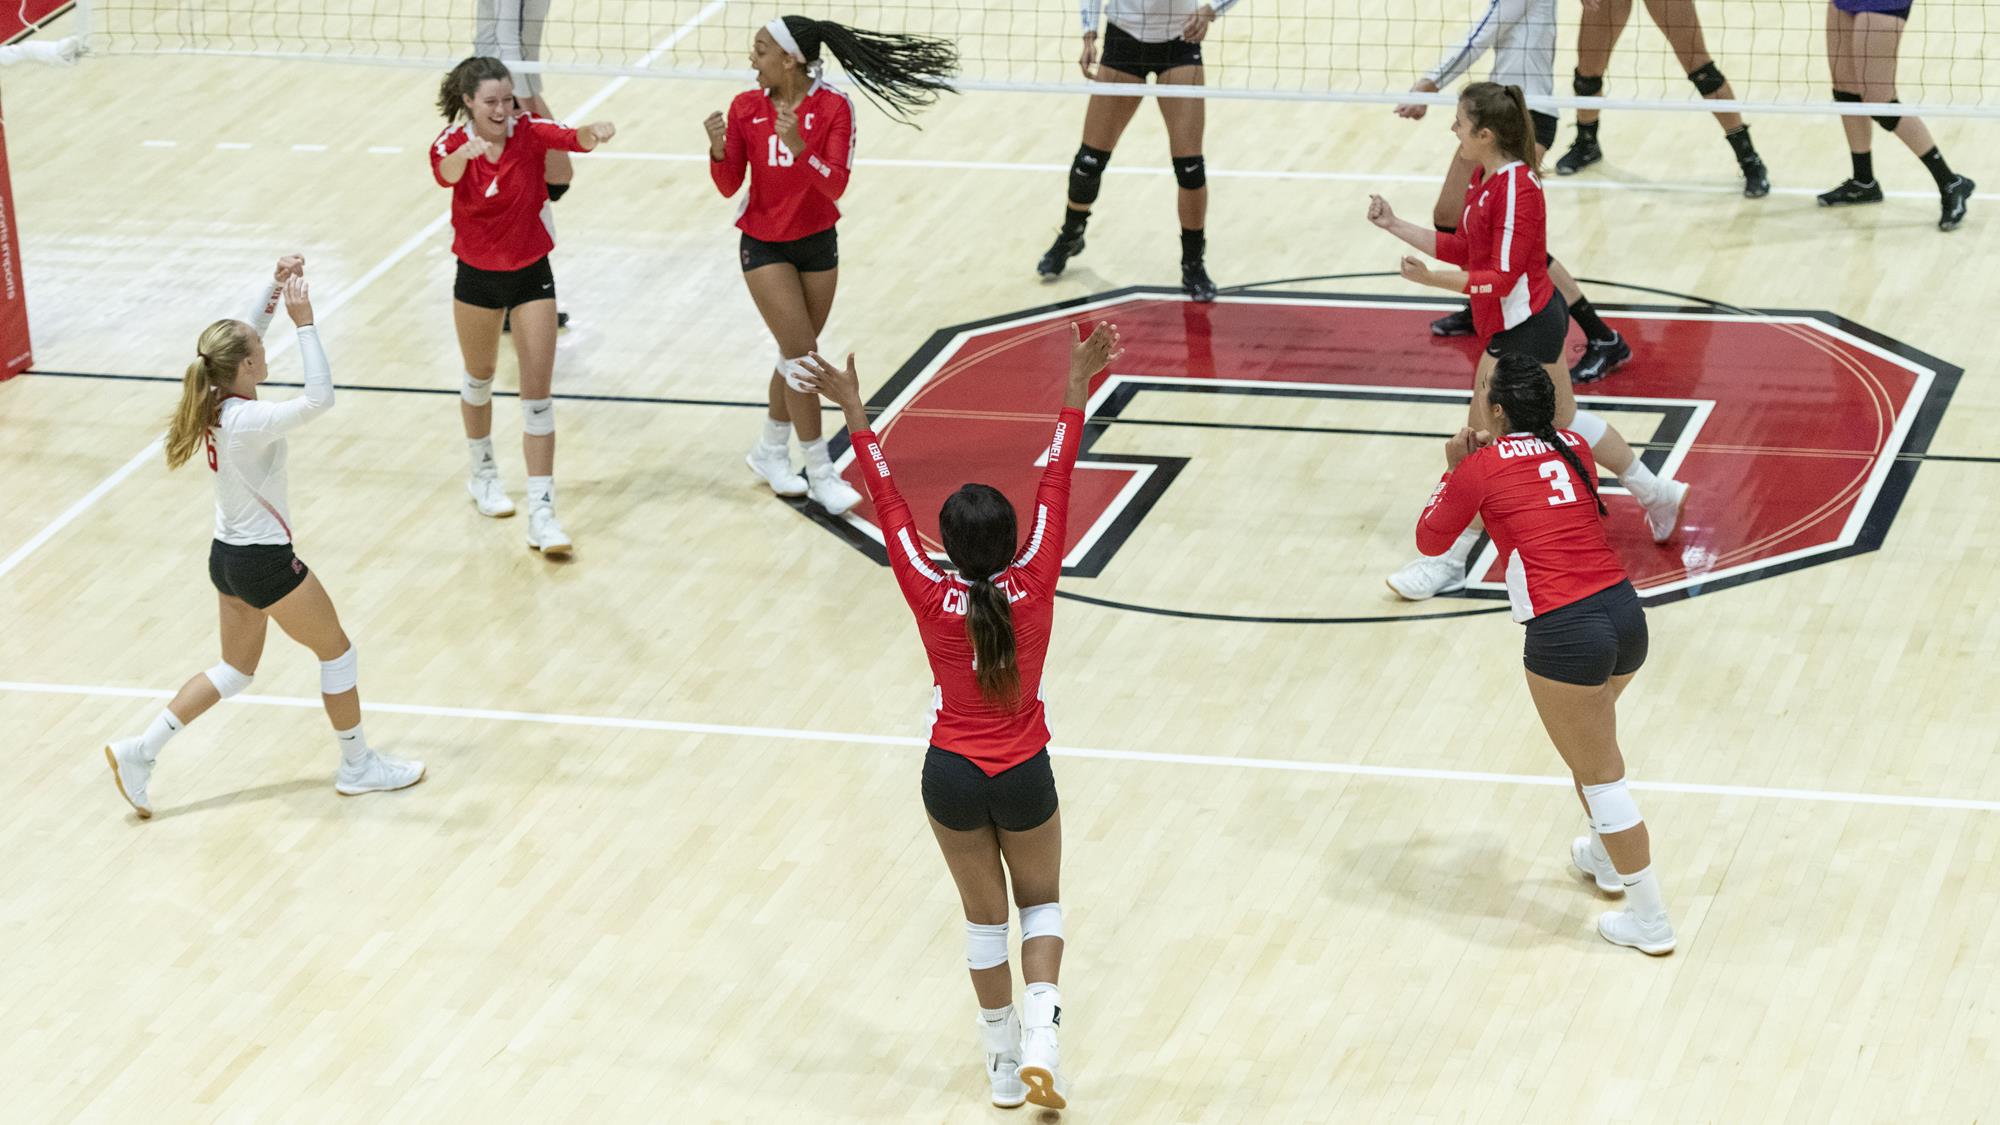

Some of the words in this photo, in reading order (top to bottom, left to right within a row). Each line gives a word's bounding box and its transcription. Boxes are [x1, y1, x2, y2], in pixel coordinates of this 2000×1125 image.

[804, 112, 815, 130] C
[767, 134, 795, 168] 15
[867, 442, 884, 462] RED
[1048, 421, 1067, 463] CORNELL
[875, 460, 891, 478] BIG
[1538, 459, 1577, 506] 3
